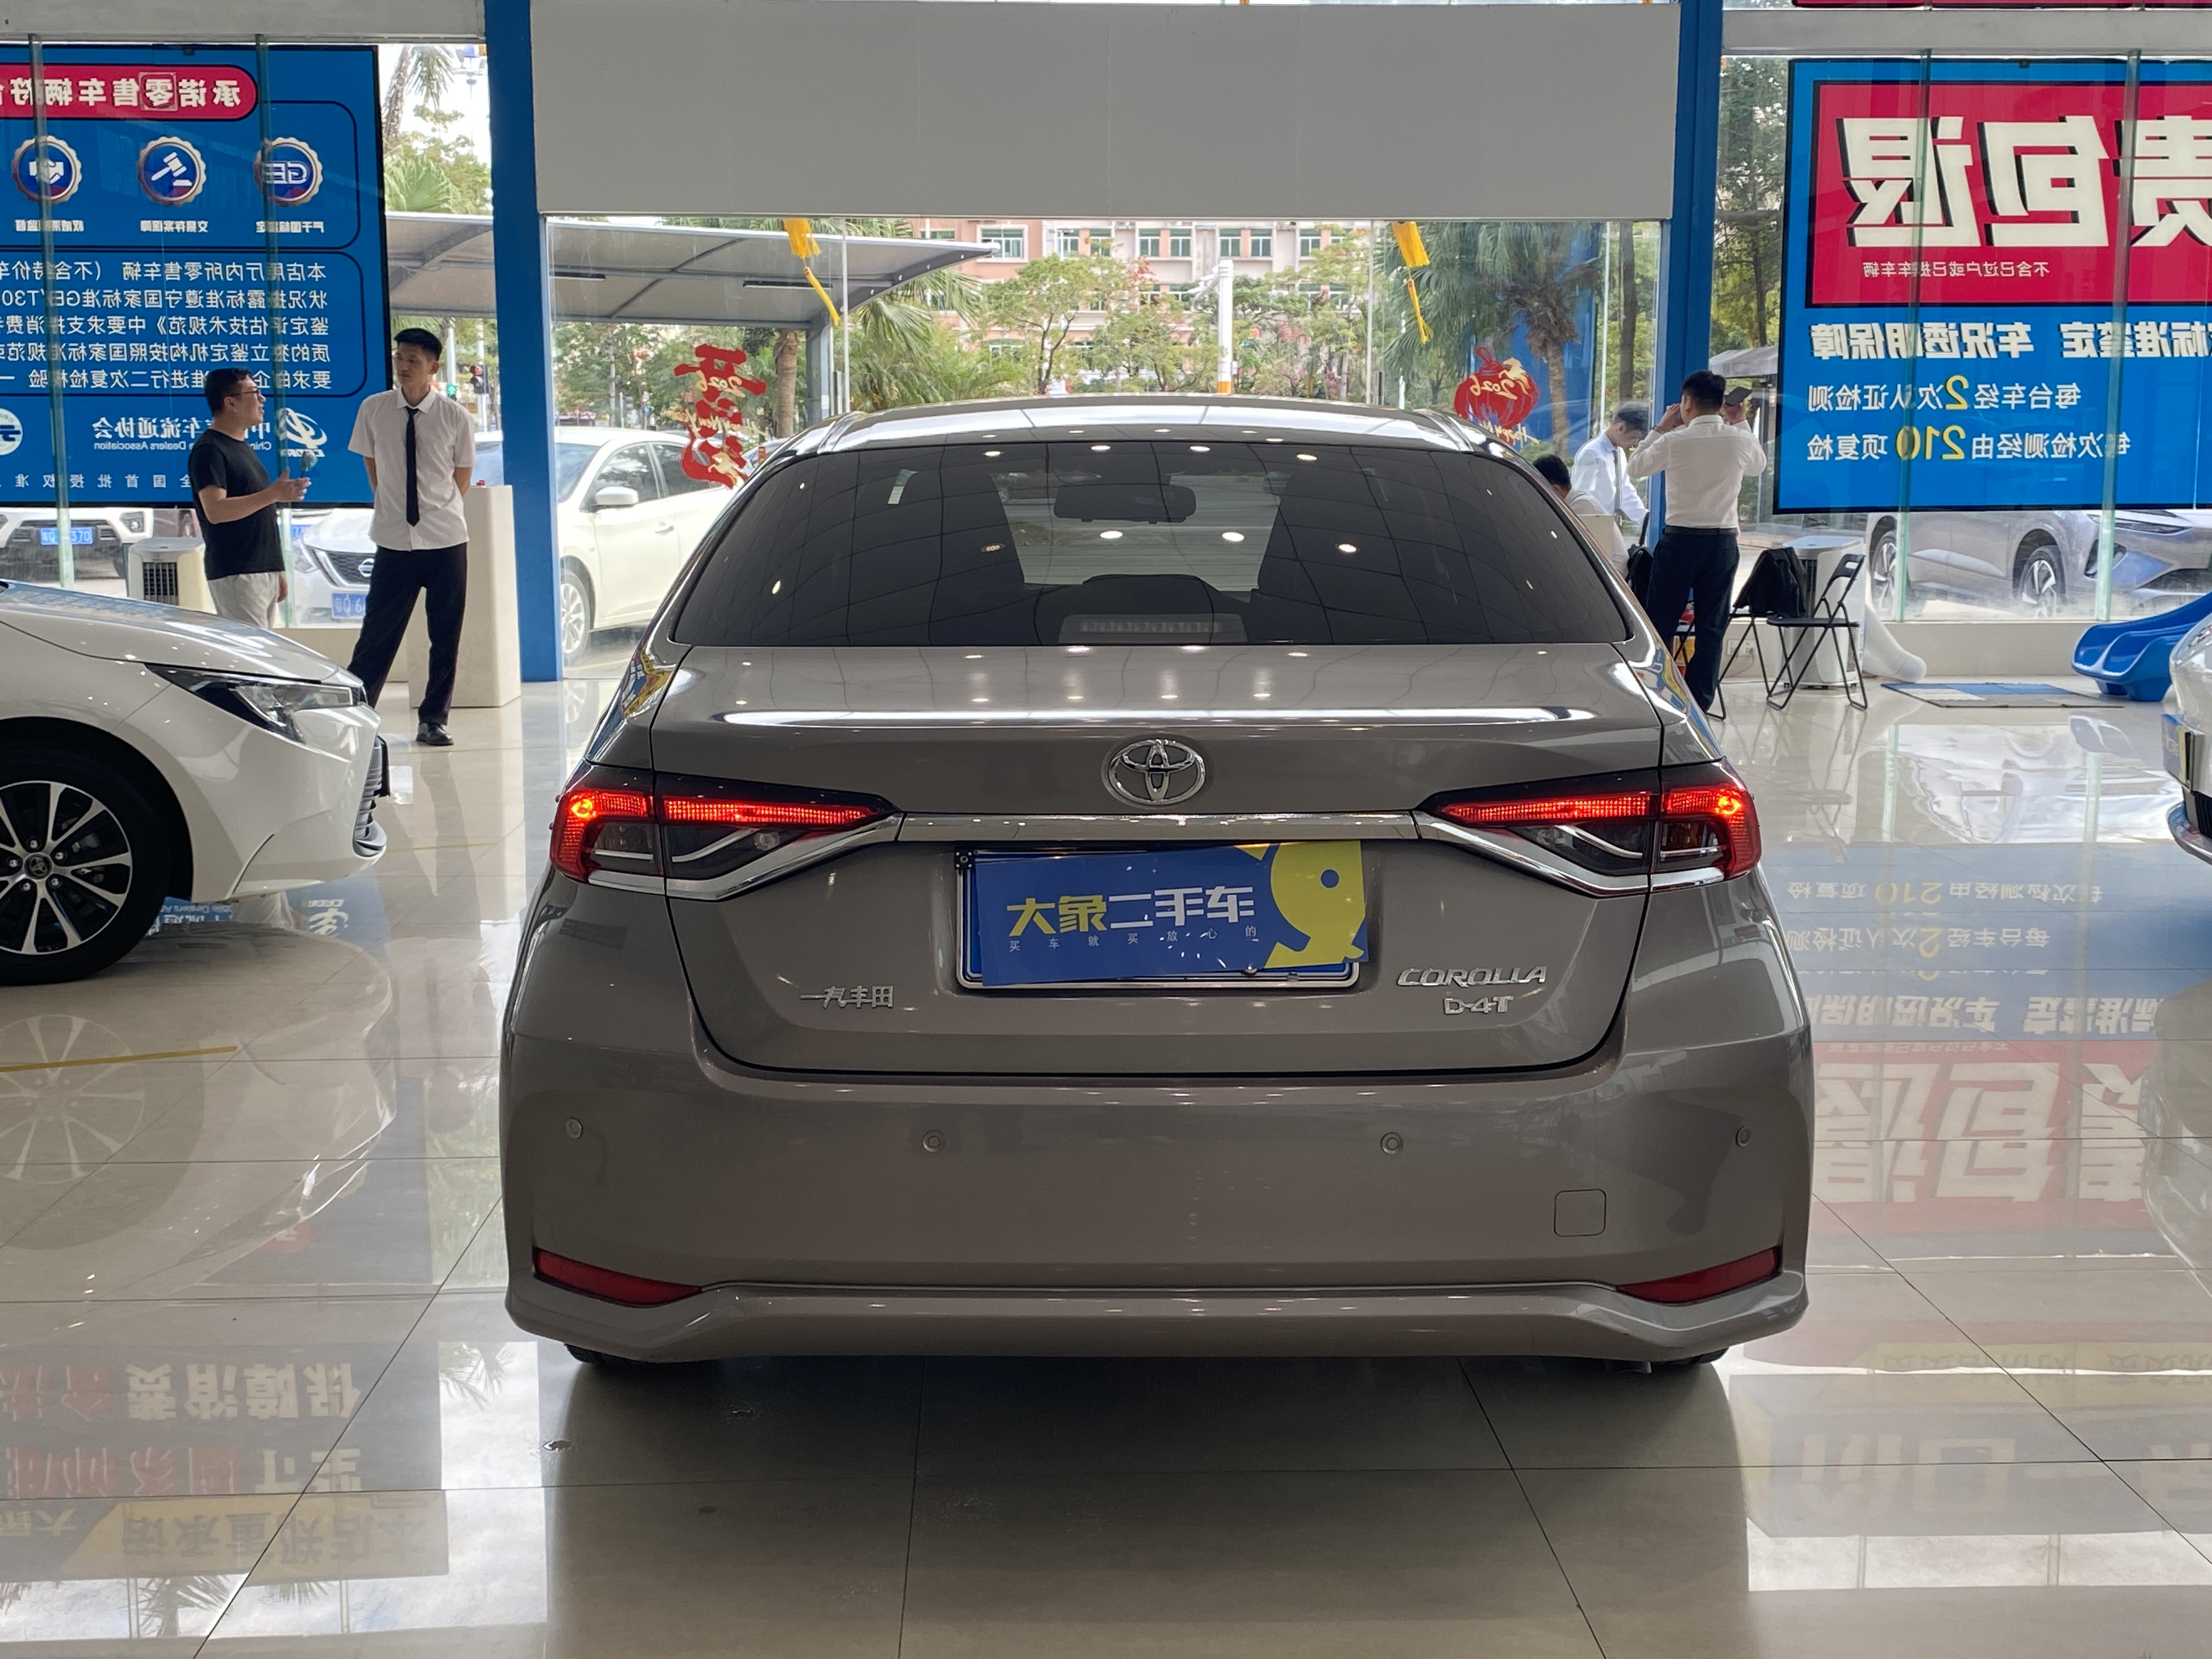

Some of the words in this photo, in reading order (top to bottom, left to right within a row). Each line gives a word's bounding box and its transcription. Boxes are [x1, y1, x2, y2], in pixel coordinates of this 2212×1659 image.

[1007, 885, 1255, 937] 大象二手车
[1009, 924, 1257, 952] 买车就买放心的
[1397, 966, 1547, 988] COROLLA
[800, 985, 894, 1008] 一汽丰田
[1443, 995, 1514, 1014] D-4T
